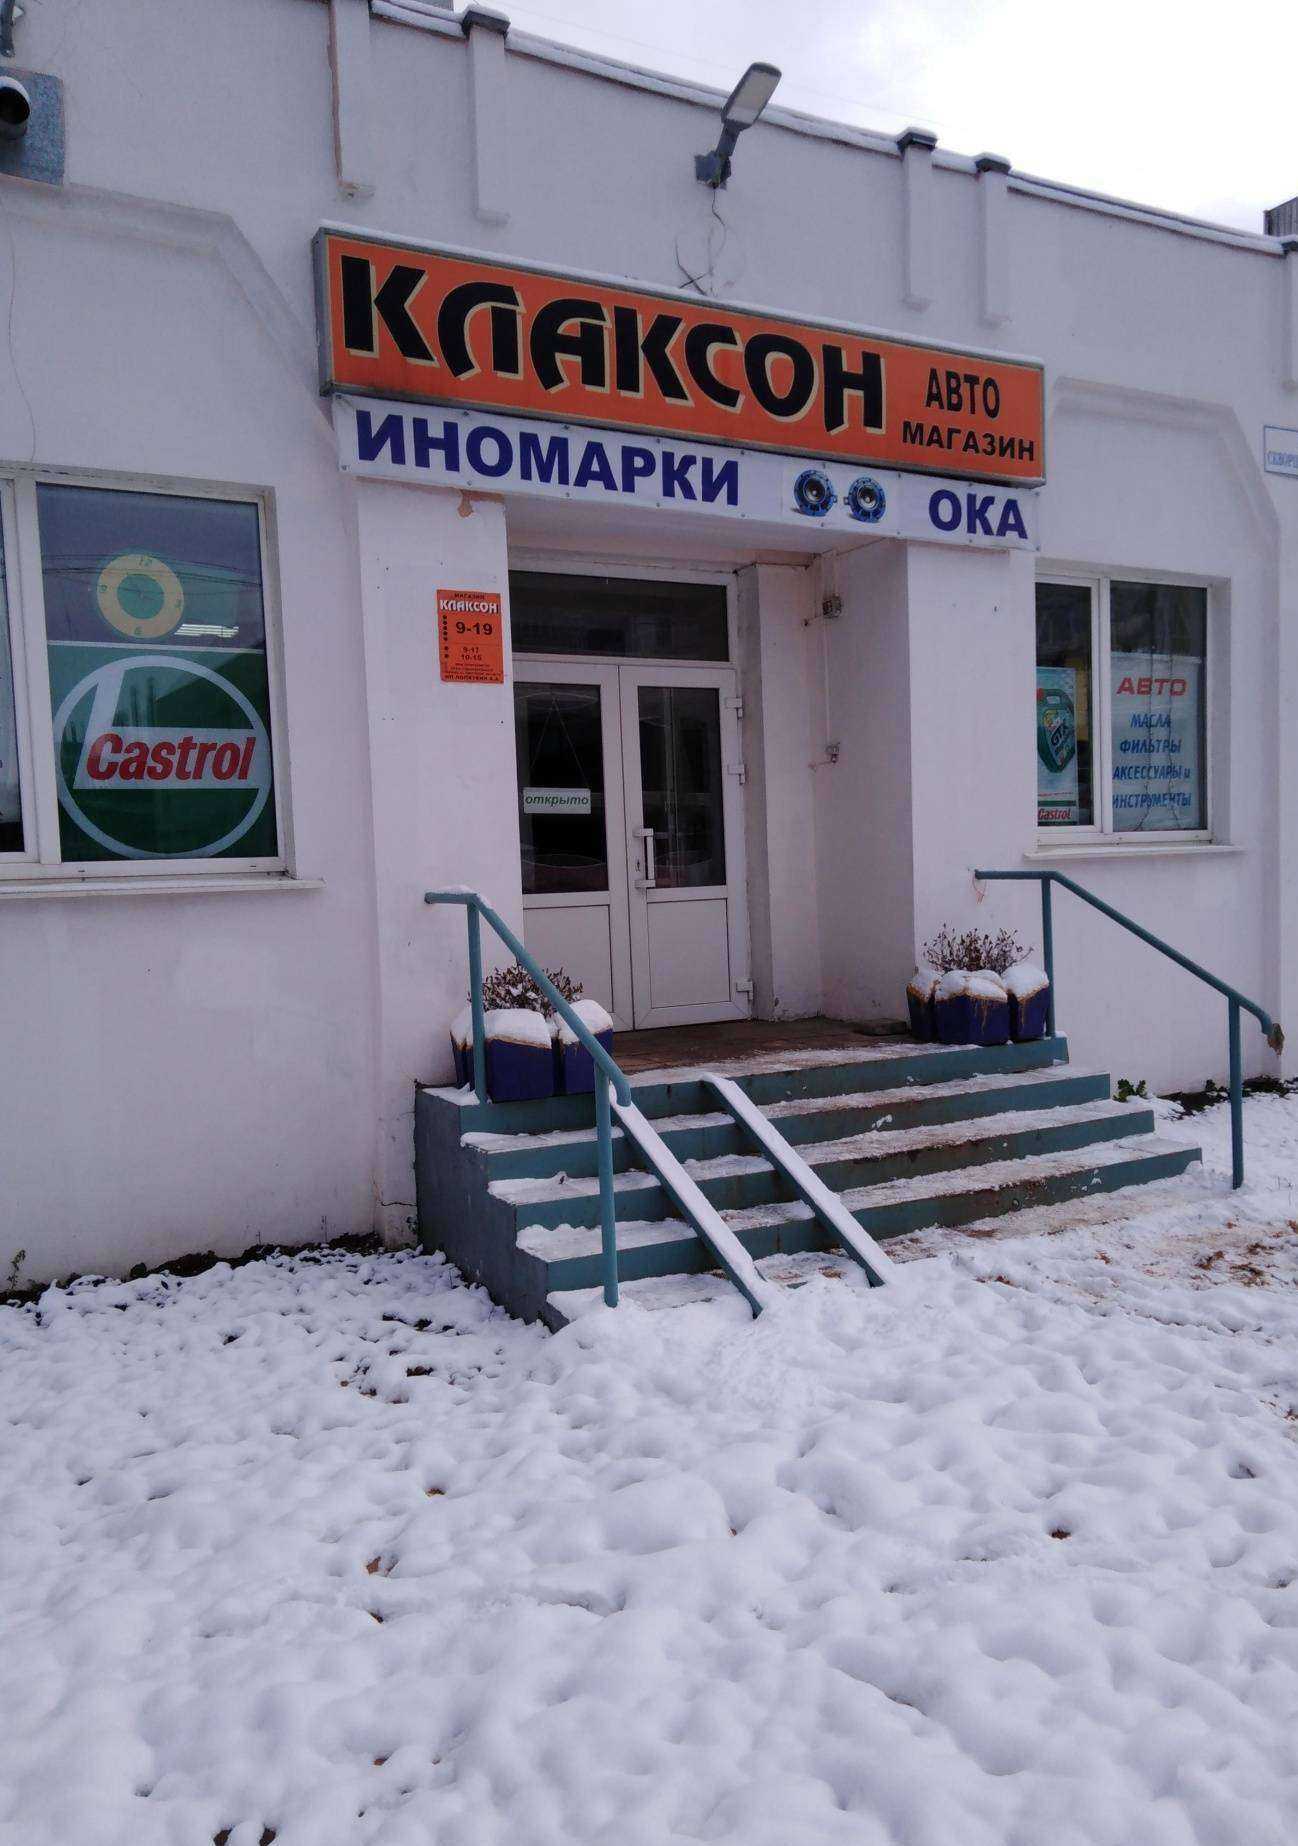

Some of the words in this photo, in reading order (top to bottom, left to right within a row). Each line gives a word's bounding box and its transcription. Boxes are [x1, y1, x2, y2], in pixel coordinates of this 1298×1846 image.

[341, 254, 887, 436] КЛАКСОН
[924, 367, 1001, 419] АВТО
[902, 419, 1035, 462] МАГАЗИН
[356, 411, 740, 505] ИНОМАРКИ
[928, 488, 1028, 541] ОКА
[440, 599, 499, 614] КЛАКСОН
[455, 621, 493, 636] 9-19
[1116, 677, 1187, 697] АВТО
[1130, 713, 1171, 728] МАСЛА
[1119, 738, 1182, 754] ФИЛЬТРЫ
[86, 733, 257, 781] Castrol
[1112, 766, 1181, 780] АКСЕССУАРЫ
[525, 796, 589, 807] открыто
[1112, 792, 1192, 809] ИНСТРУМЕНТЫ
[1037, 808, 1072, 820] Castrol
